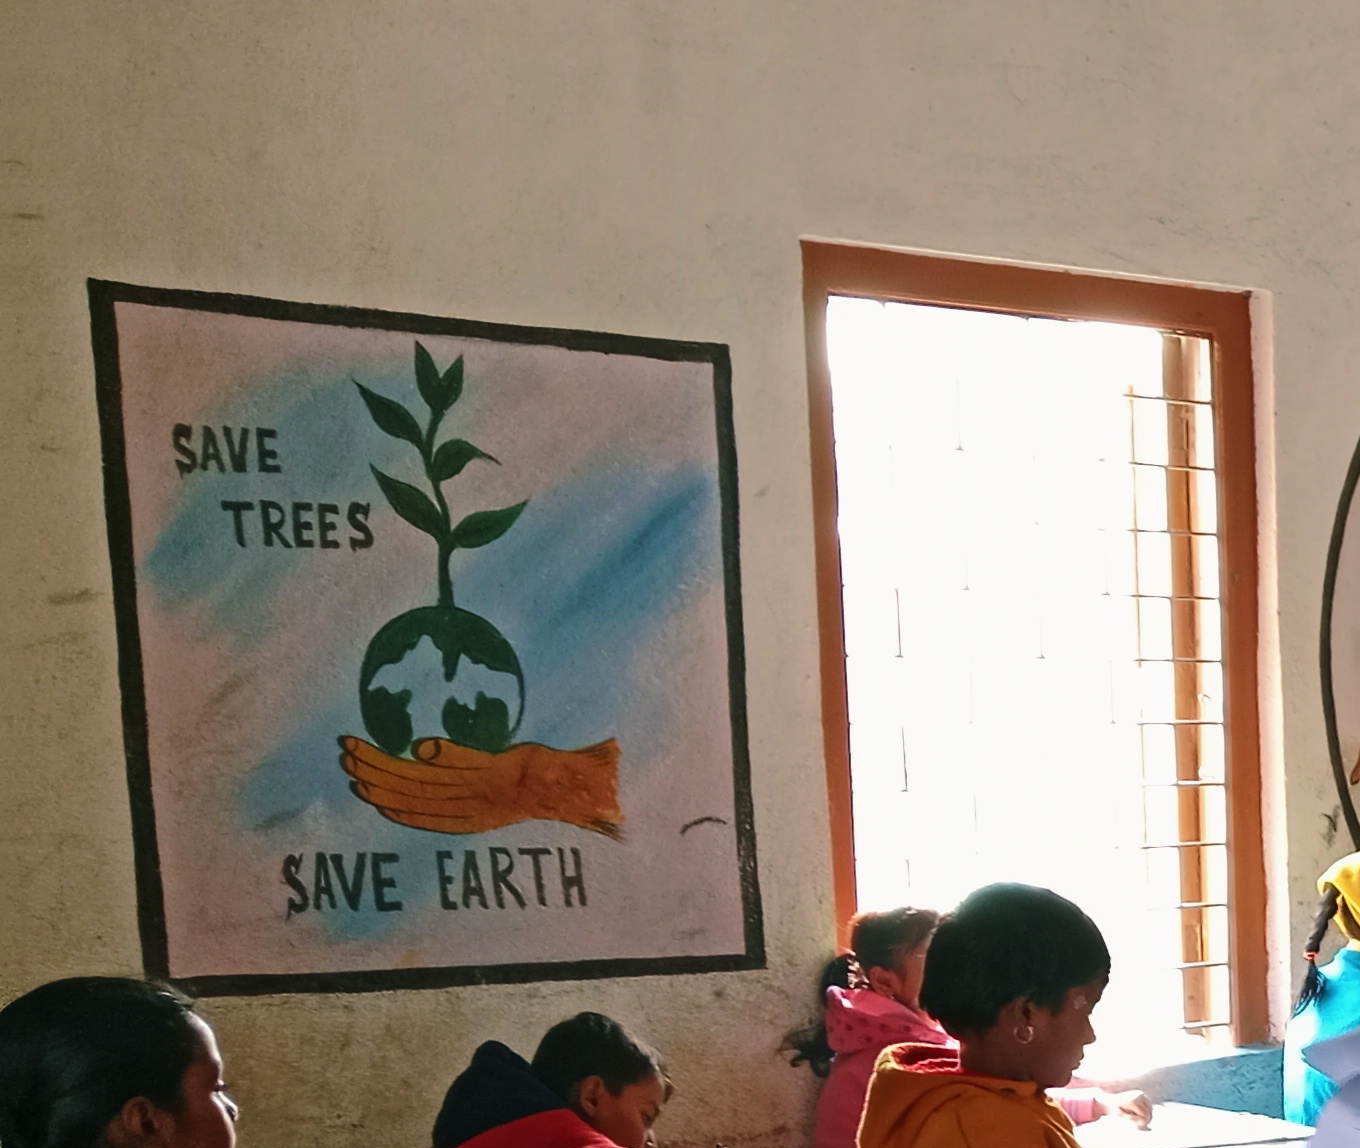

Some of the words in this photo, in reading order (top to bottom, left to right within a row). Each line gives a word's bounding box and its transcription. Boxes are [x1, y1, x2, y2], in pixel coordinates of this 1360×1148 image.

[171, 424, 283, 479] SAVE
[220, 500, 376, 550] TREES
[282, 851, 404, 920] SAVE
[438, 847, 589, 910] EARTH
